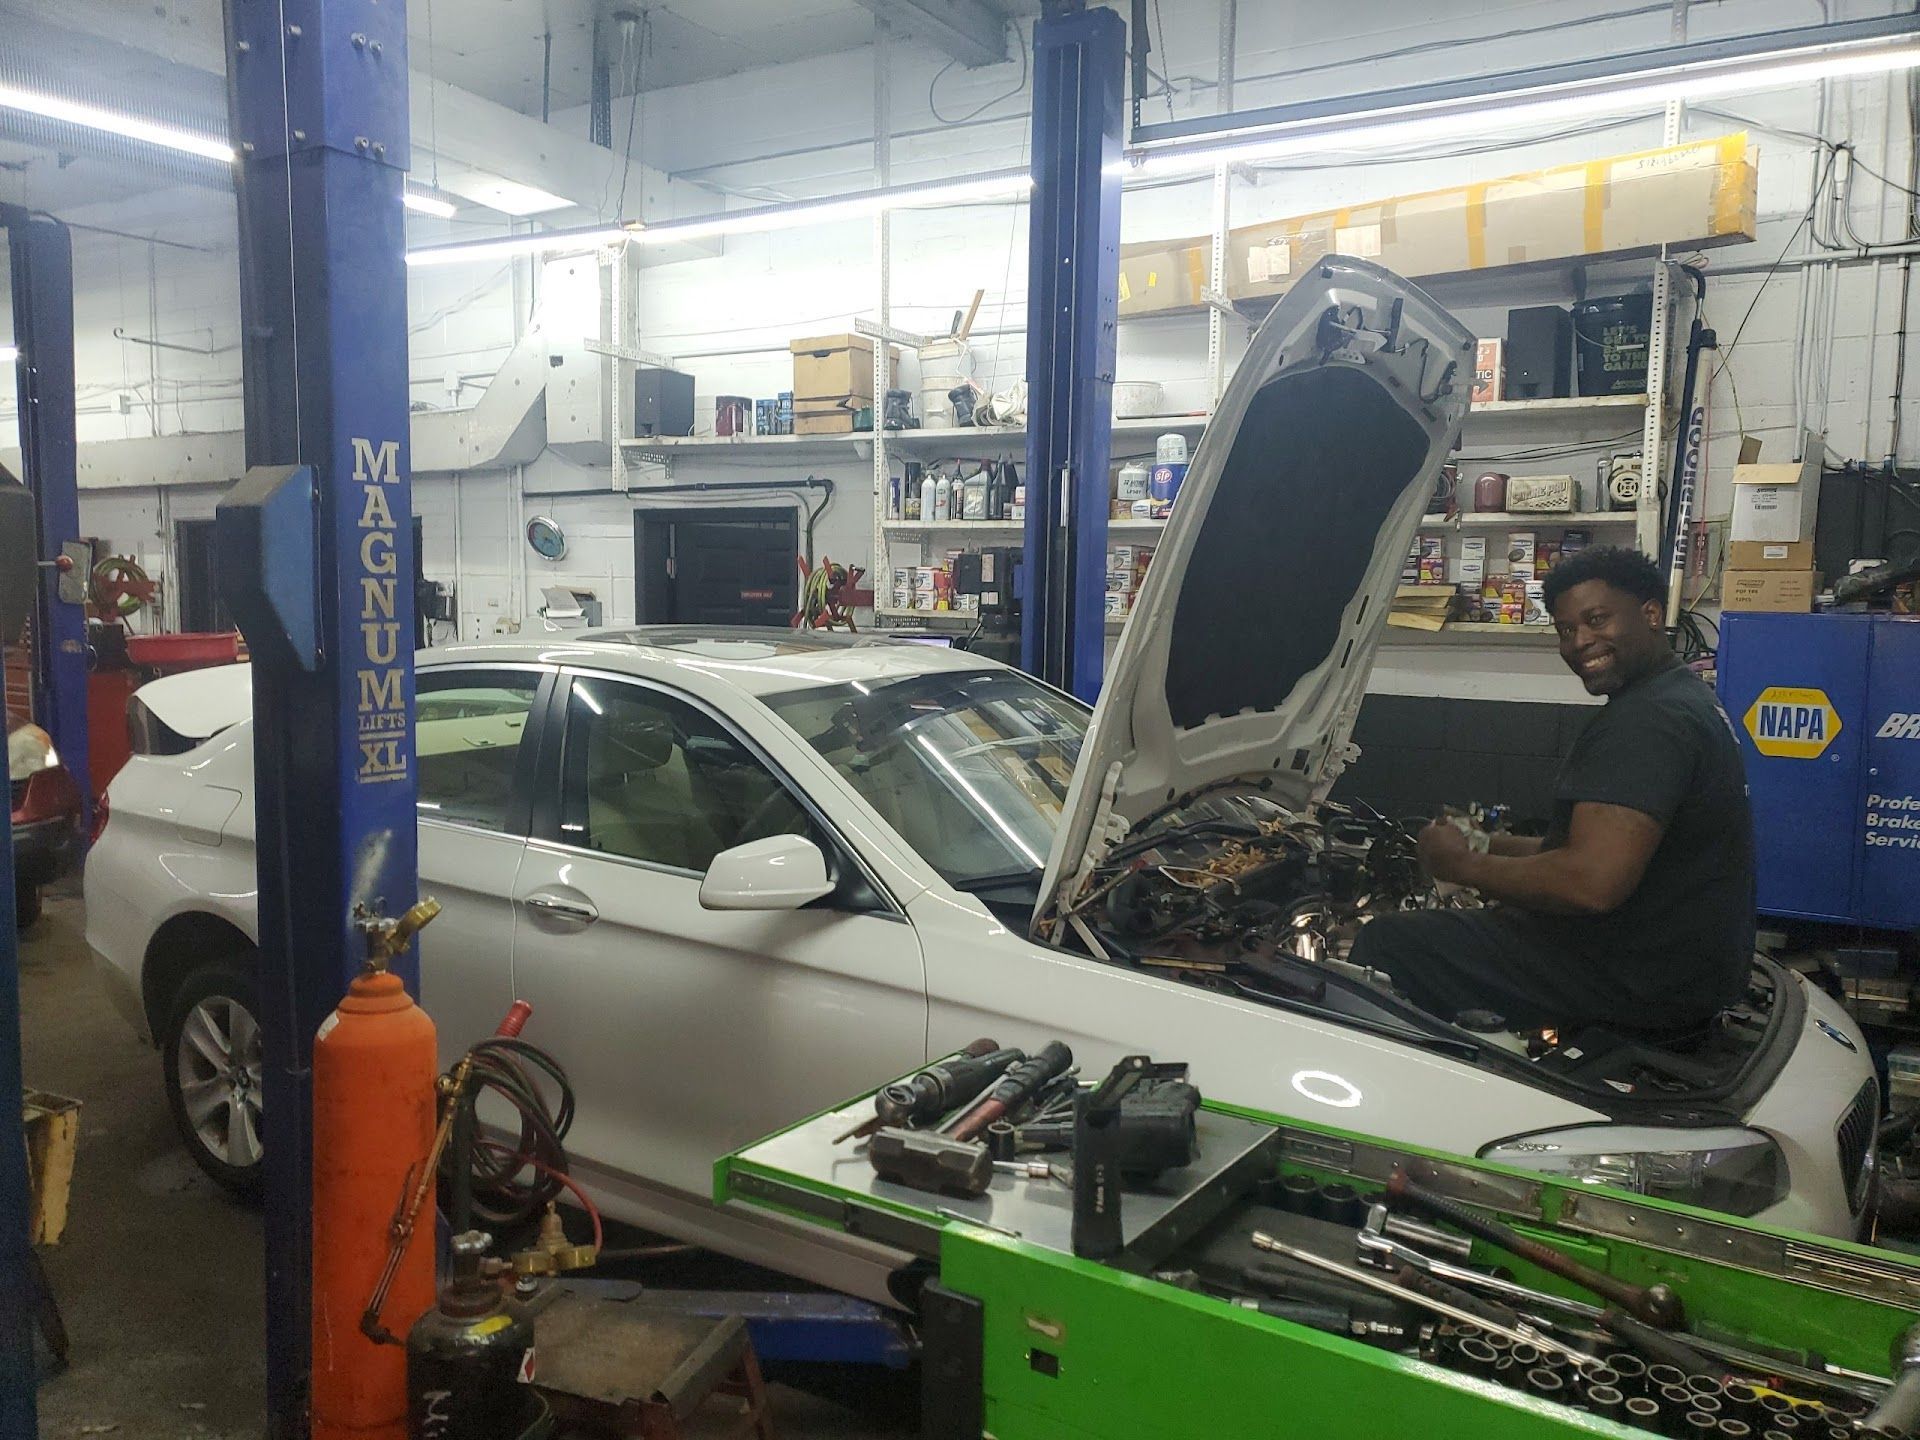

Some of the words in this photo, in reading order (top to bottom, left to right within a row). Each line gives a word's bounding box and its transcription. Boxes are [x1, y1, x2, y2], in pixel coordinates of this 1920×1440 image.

[1604, 361, 1648, 371] GARAG
[1156, 470, 1170, 481] STP
[352, 437, 405, 711] MAGNUM
[358, 712, 406, 732] LIFTS
[1759, 705, 1824, 740] NAPA
[1875, 712, 1920, 739] BR
[360, 740, 407, 775] XL
[1866, 812, 1920, 830] Brake
